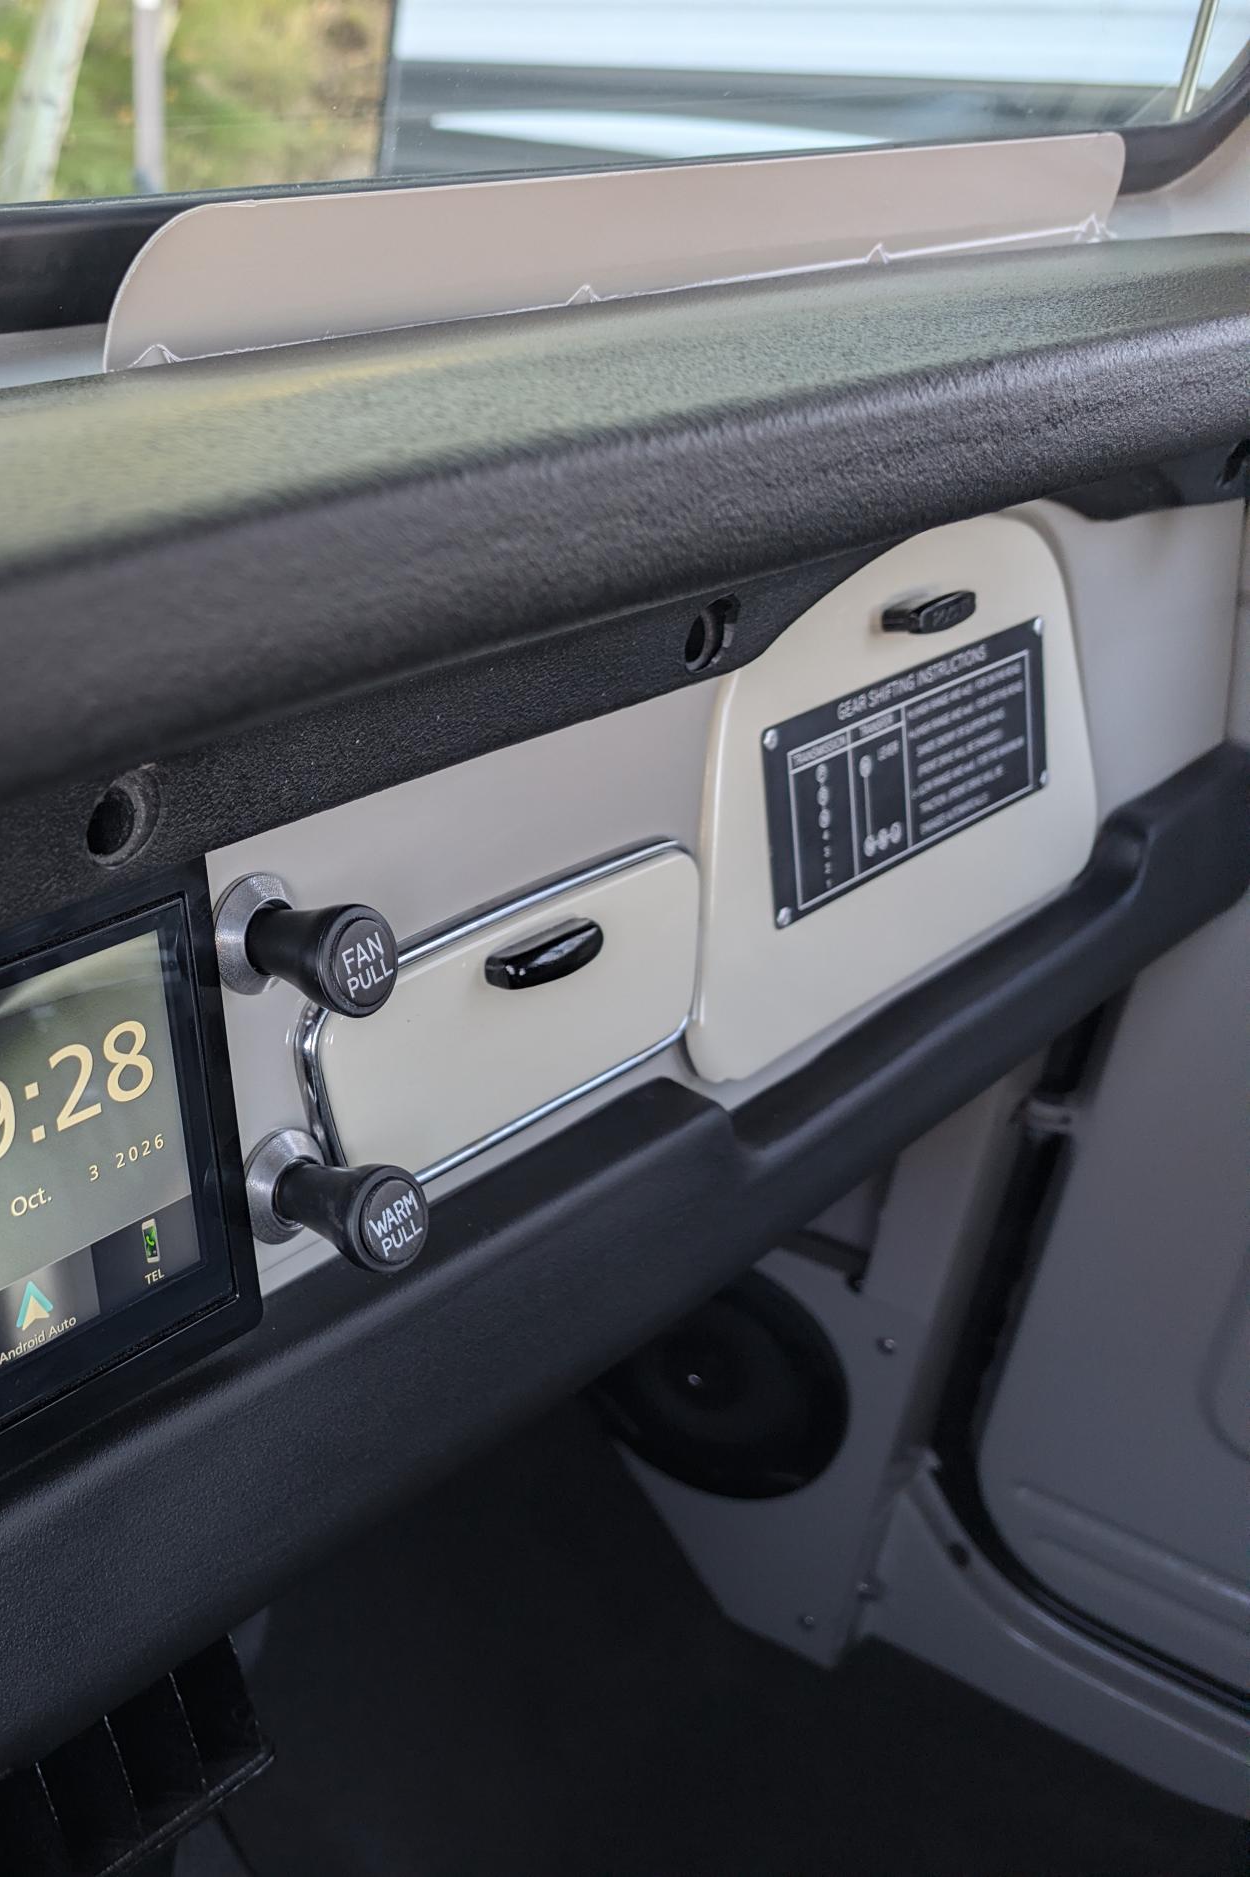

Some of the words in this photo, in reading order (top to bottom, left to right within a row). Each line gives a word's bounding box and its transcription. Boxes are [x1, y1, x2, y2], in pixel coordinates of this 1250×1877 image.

[837, 693, 867, 720] GEAR
[868, 673, 915, 709] SHIFTING
[916, 643, 988, 687] INSTRUCTIONS
[342, 931, 384, 975] FAN
[347, 958, 394, 998] PULL
[10, 1187, 53, 1217] Oct.
[88, 1164, 100, 1182] 3
[115, 1133, 165, 1170] 2026
[368, 1190, 420, 1238] WARM
[381, 1219, 423, 1257] PULL
[144, 1268, 165, 1286] TEL
[48, 1315, 78, 1340] Auto
